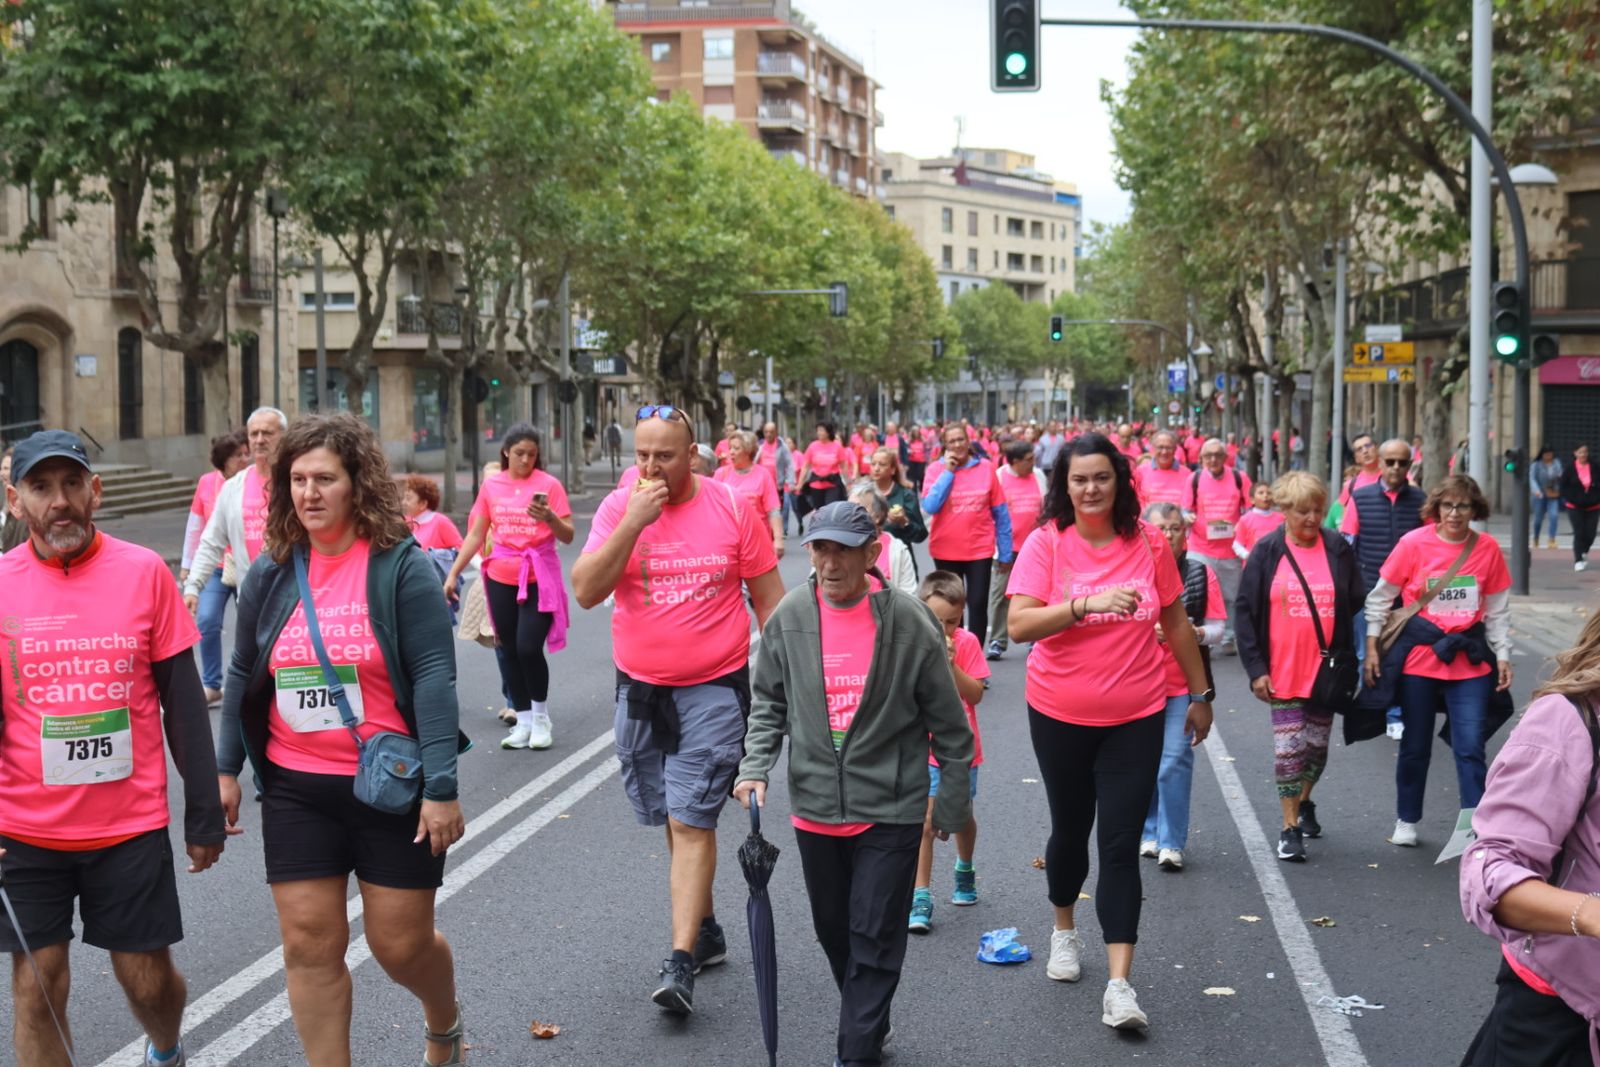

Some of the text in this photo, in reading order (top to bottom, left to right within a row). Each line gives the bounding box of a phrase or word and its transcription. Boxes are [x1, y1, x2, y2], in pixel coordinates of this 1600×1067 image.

[650, 553, 728, 571] En marcha
[652, 567, 727, 587] contra el
[653, 586, 722, 604] cáncer
[1072, 584, 1092, 595] En
[1438, 589, 1467, 601] 5826
[349, 619, 372, 638] el
[21, 632, 138, 654] En marcha
[22, 653, 134, 678] contra el
[27, 678, 134, 704] cáncer
[65, 736, 113, 761] 7375
